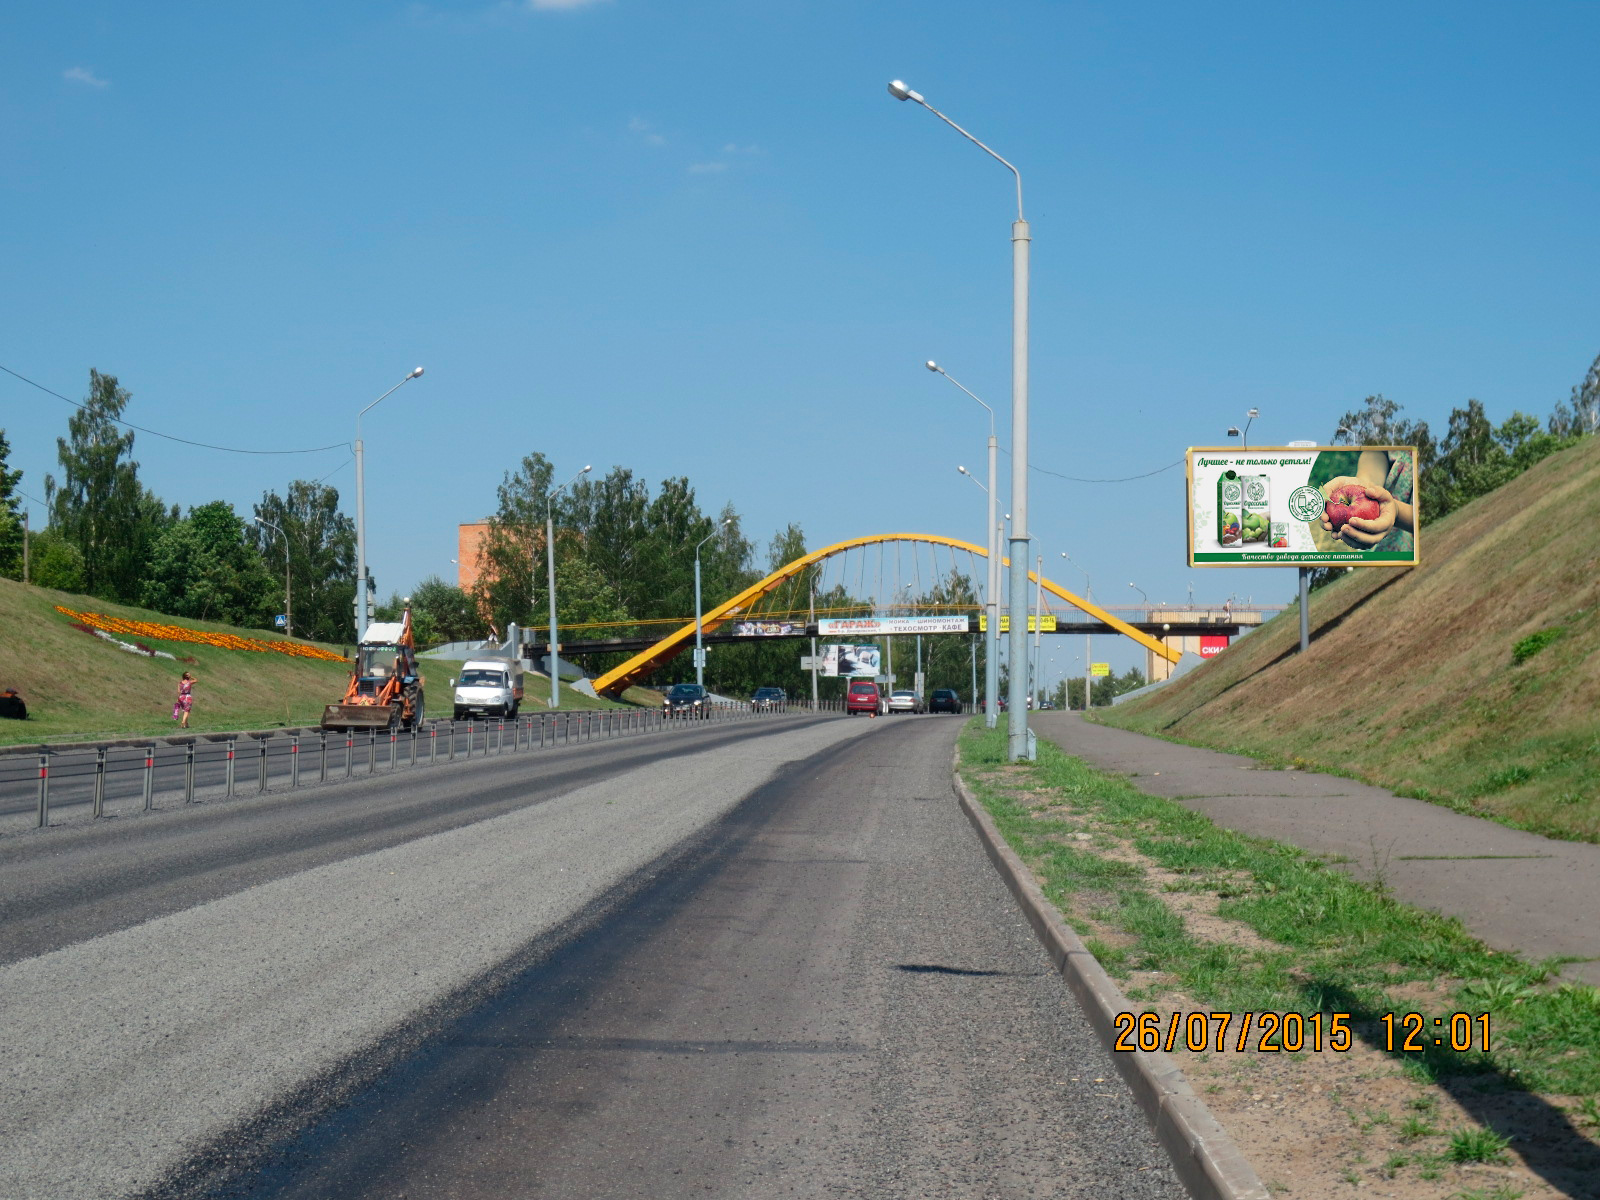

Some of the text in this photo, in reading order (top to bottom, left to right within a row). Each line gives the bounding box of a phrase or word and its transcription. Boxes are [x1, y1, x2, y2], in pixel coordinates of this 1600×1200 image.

[1197, 457, 1229, 467] Лучшее
[1235, 458, 1246, 466] не
[1246, 457, 1278, 466] только
[1279, 456, 1312, 467] детям!
